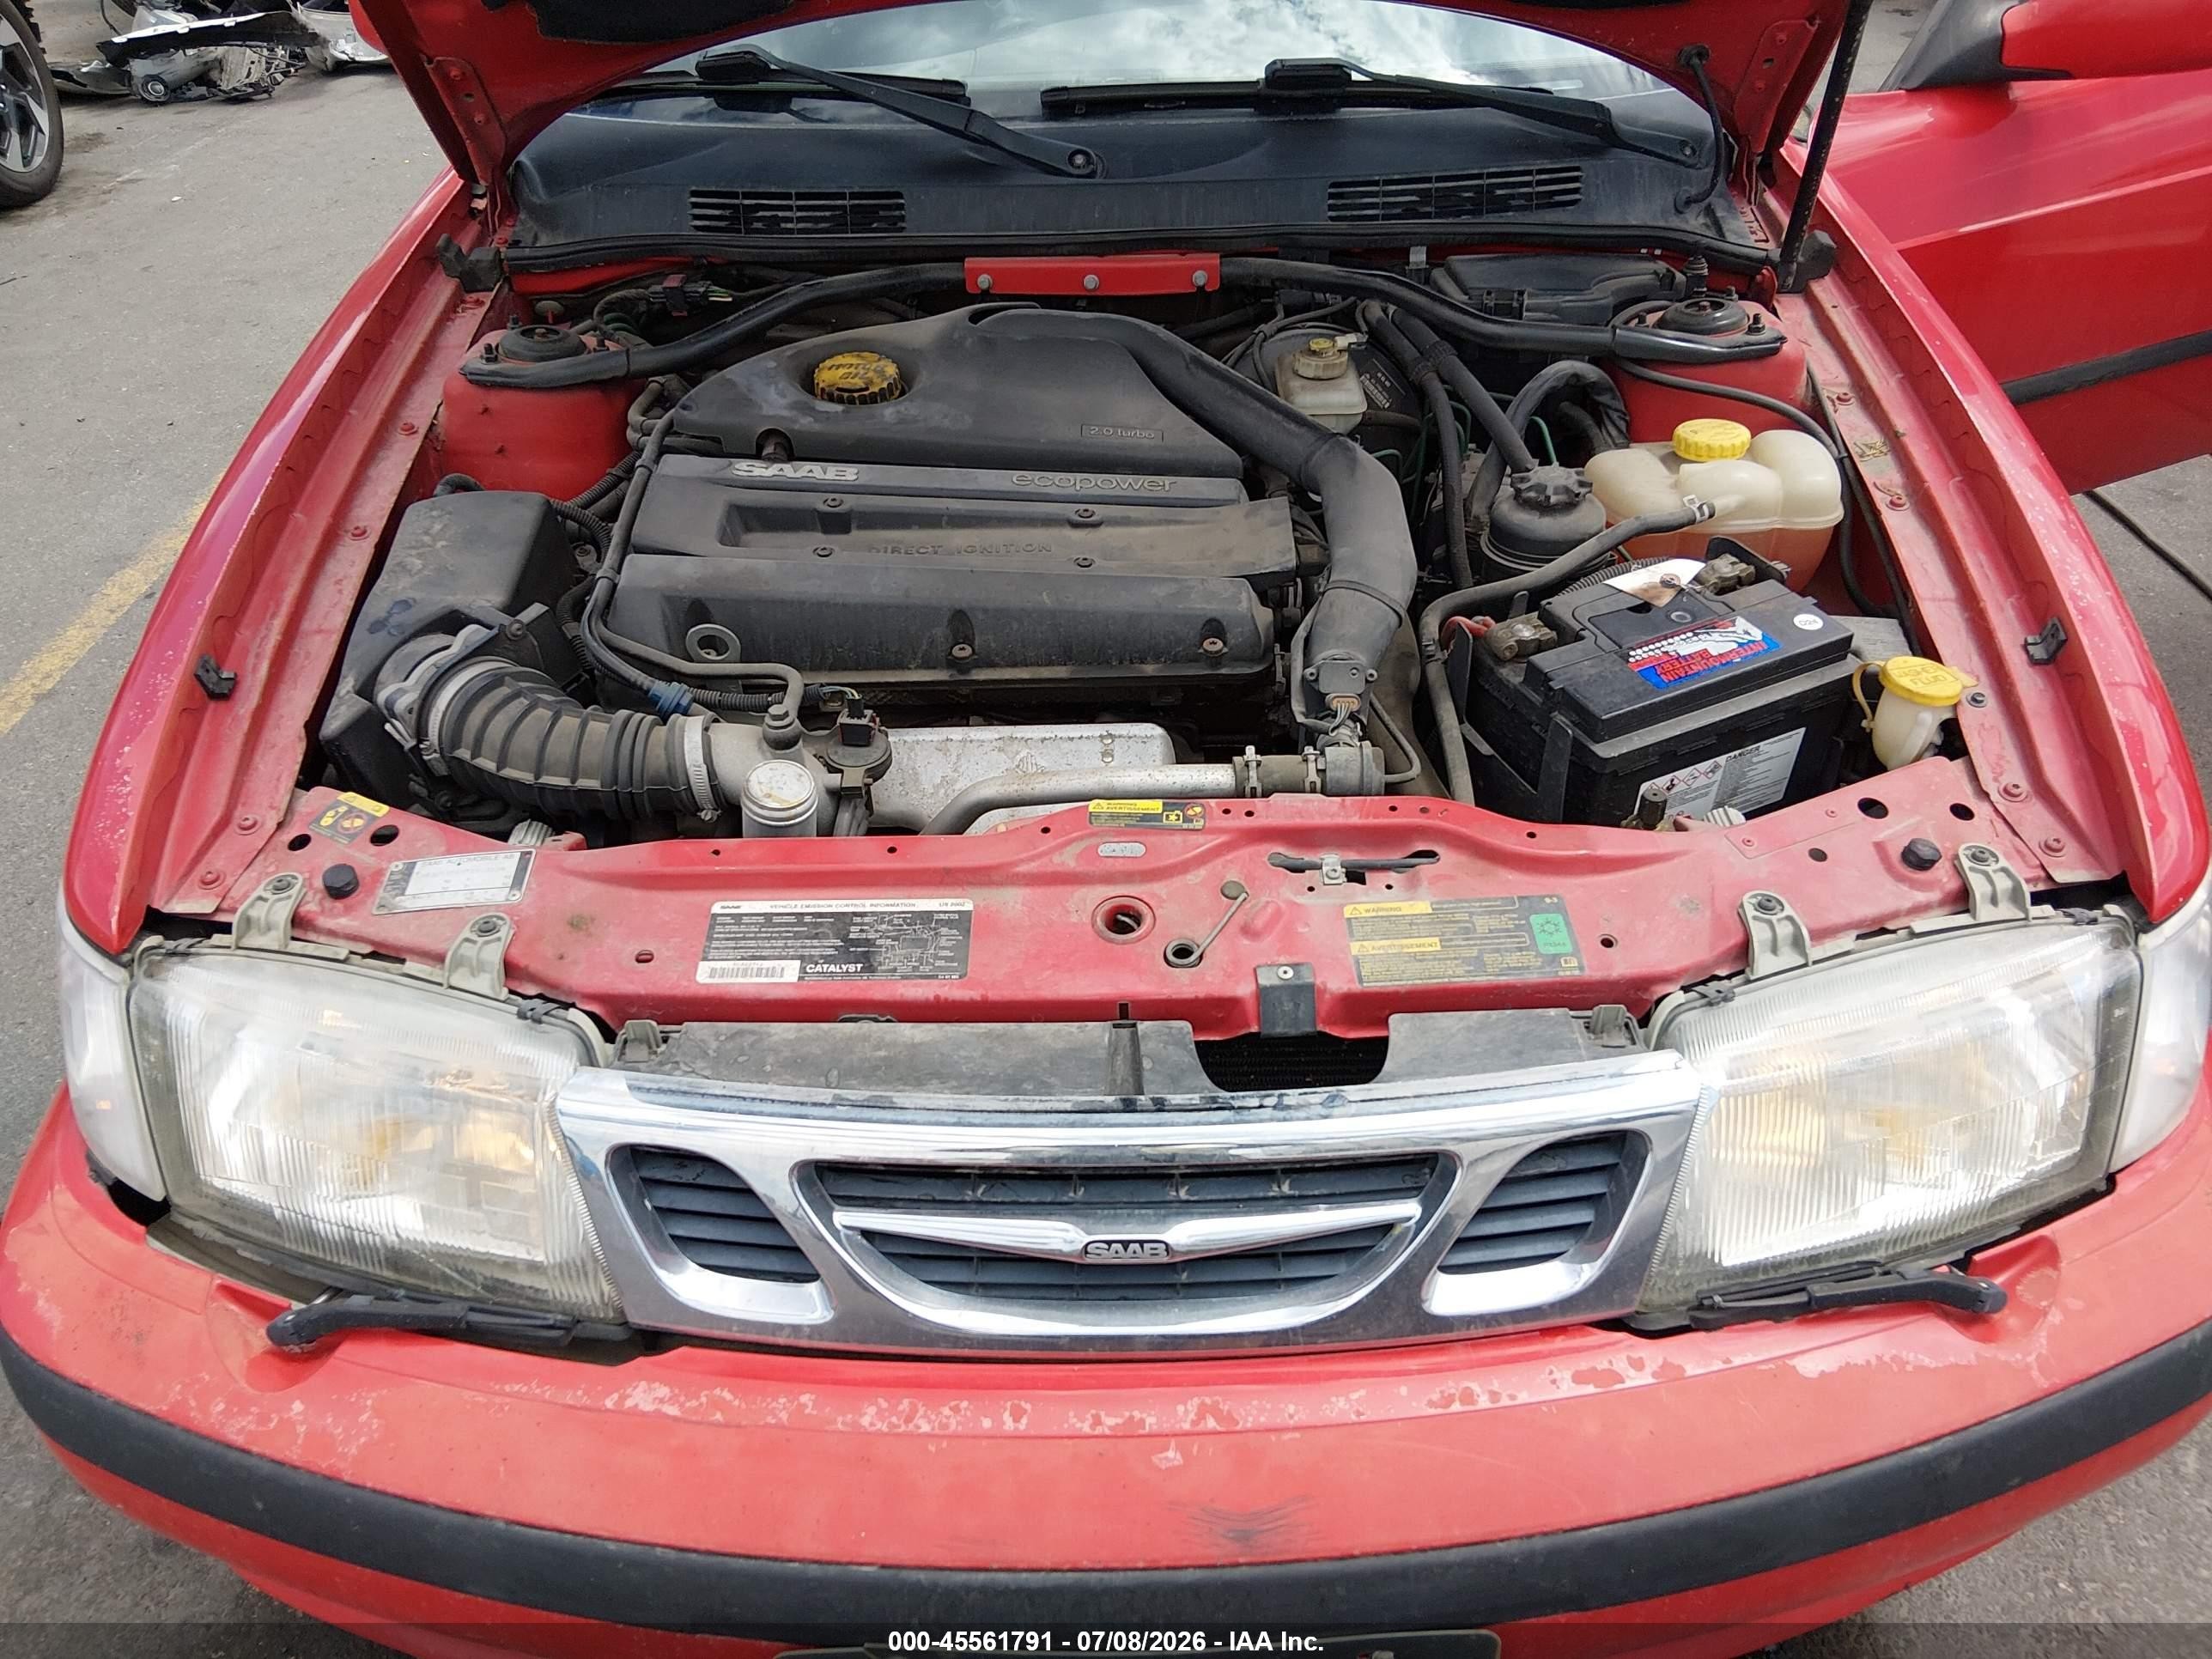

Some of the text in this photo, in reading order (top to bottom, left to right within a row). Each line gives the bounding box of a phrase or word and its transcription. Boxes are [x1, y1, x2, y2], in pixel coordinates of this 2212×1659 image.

[1089, 427, 1154, 440] 2.0 turbo
[732, 461, 859, 482] SAAB
[1012, 473, 1177, 492] ecopower
[867, 543, 1052, 556] DIRECT IGNITION
[1654, 648, 1711, 672] BATTERY
[1660, 641, 1767, 683] INTERMOUNTAIN
[1725, 745, 1761, 763] DANGER
[805, 963, 864, 973] CATALYST
[1085, 1243, 1168, 1259] SAAB
